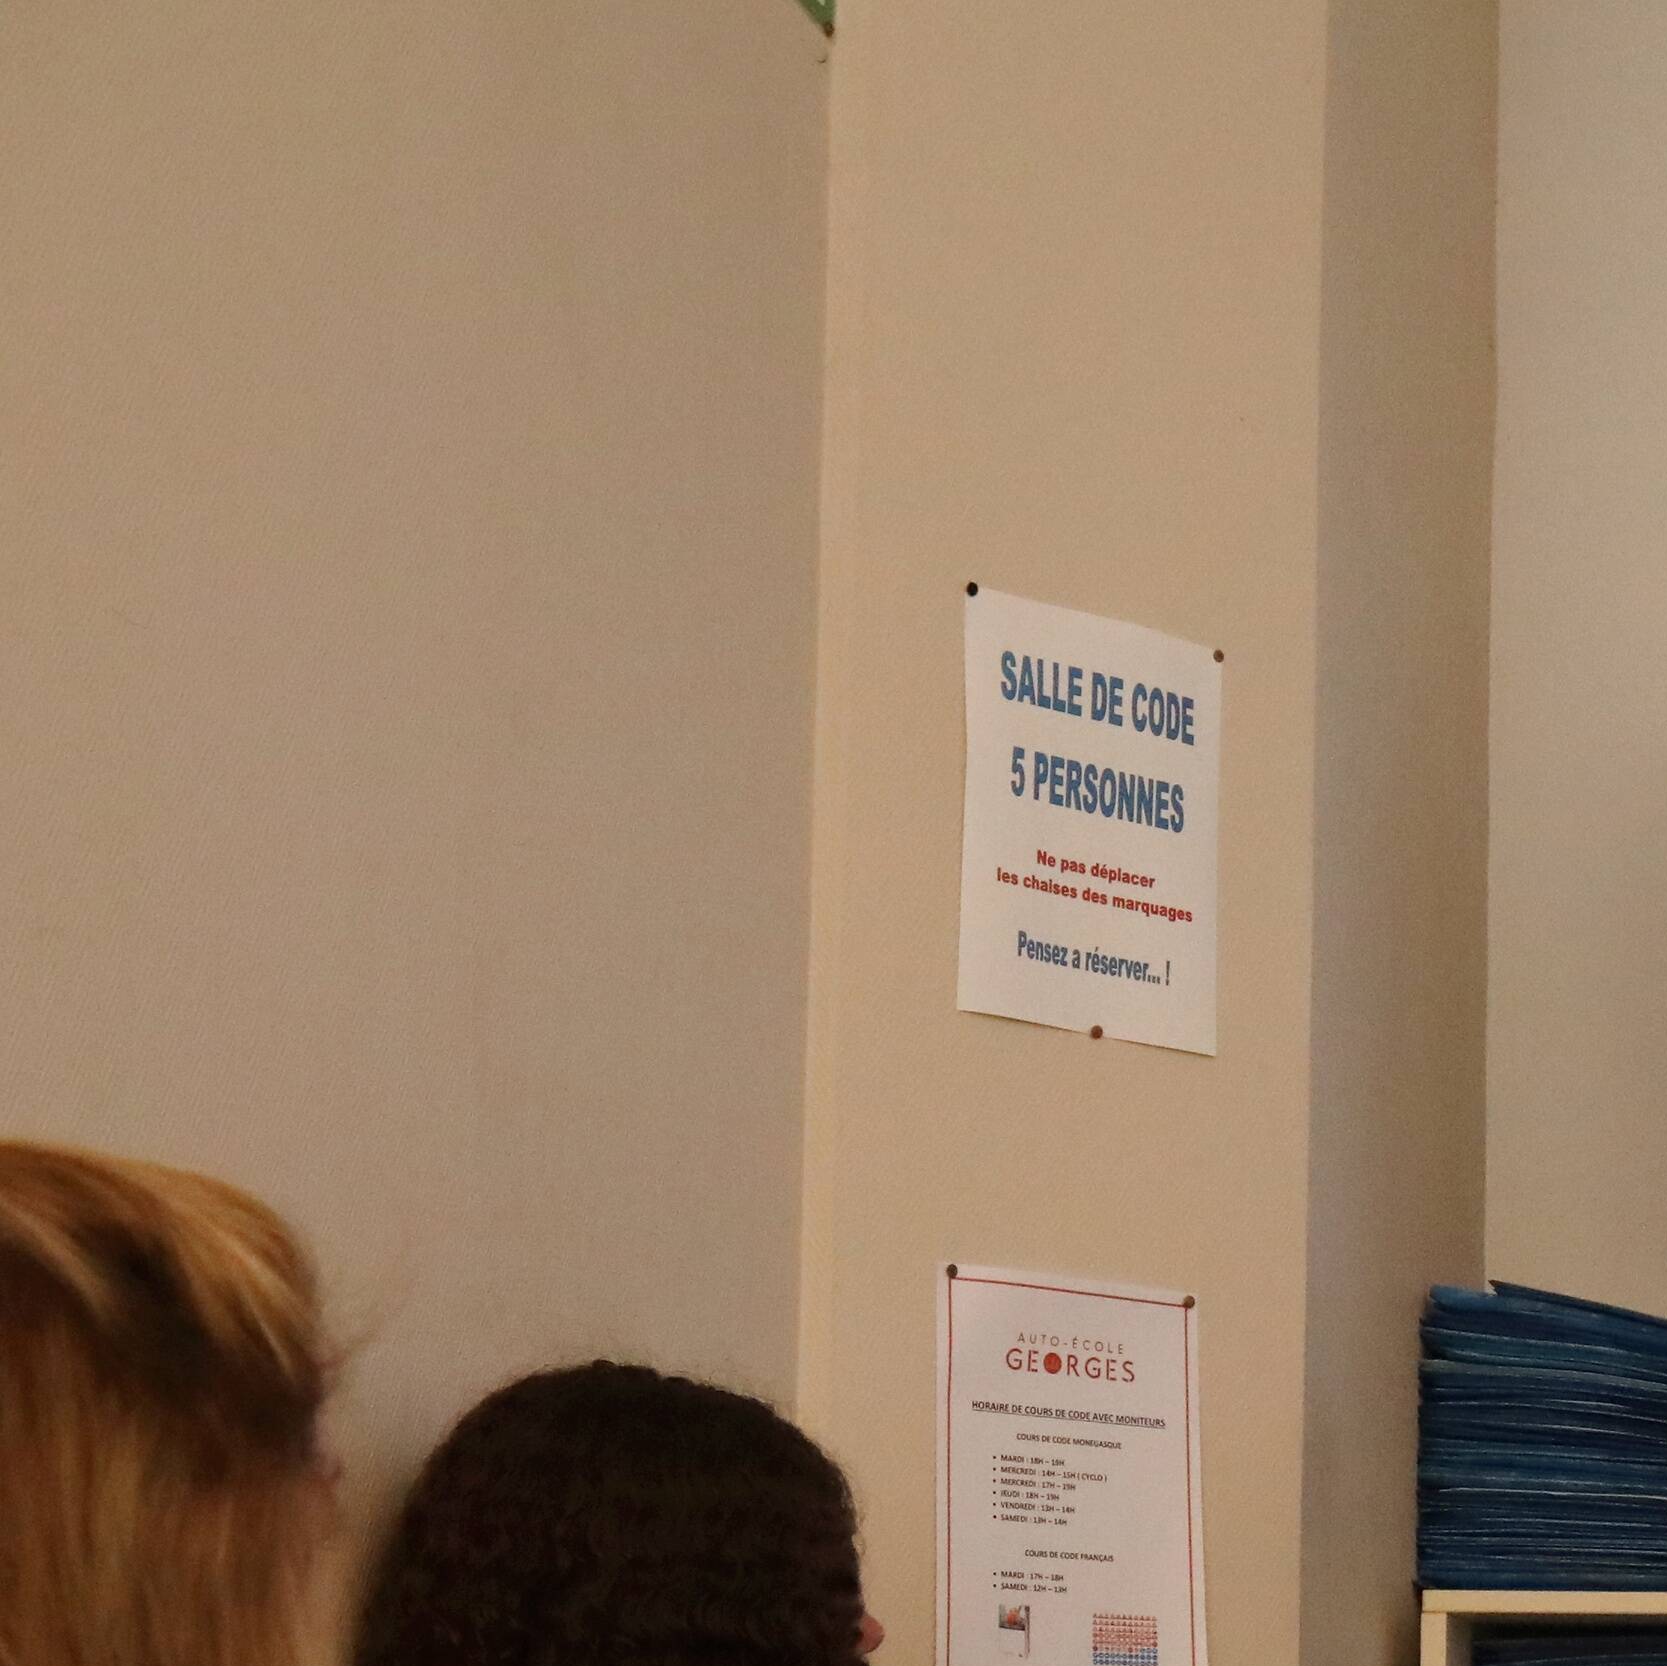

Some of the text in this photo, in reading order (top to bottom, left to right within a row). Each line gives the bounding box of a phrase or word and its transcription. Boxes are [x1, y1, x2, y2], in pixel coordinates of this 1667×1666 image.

[1000, 650, 1195, 746] SALLE DE CODE
[1011, 746, 1185, 834] 5 PERSONNES
[1036, 849, 1156, 890] Ne pas déplacer
[997, 867, 1193, 923] les chaises des marquages
[1017, 930, 1068, 967] Pensez
[1017, 1332, 1123, 1355] AUTO-ÉCOLE
[1005, 1348, 1135, 1383] GEORGES
[972, 1401, 1166, 1427] HORAIRE DE COURS DE CODE AVEC MONITEURS
[1016, 1433, 1040, 1442] COURS
[1041, 1435, 1051, 1443] DE
[1052, 1436, 1071, 1445] CODE
[1000, 1454, 1024, 1463] MARDI
[1000, 1466, 1036, 1476] MERCREDI
[1000, 1478, 1036, 1487] MERCREDI
[1000, 1501, 1035, 1511] VENDREDI
[1000, 1514, 1028, 1523] SAMEDI
[1024, 1550, 1048, 1559] COURS
[1049, 1551, 1059, 1559] DE
[1060, 1552, 1079, 1560] CODE
[1000, 1571, 1024, 1579] MARDI
[1000, 1583, 1028, 1591] SAMEDI
